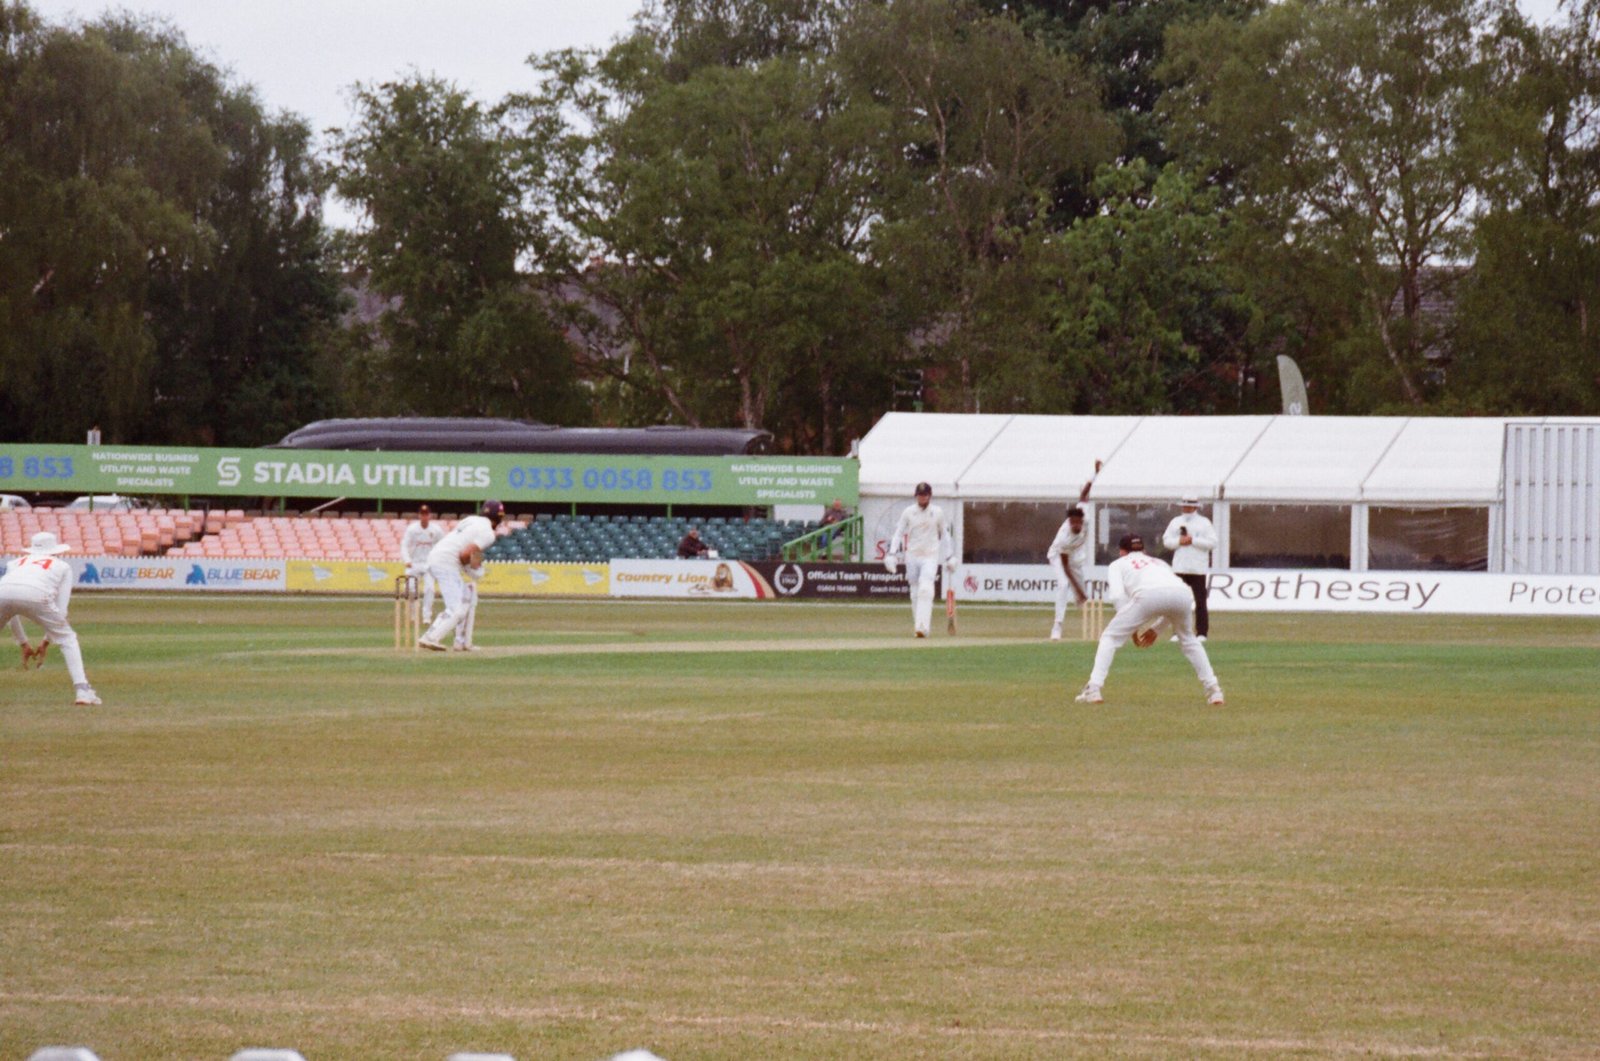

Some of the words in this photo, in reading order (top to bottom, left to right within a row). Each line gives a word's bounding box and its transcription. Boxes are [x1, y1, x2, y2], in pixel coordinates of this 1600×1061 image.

[92, 452, 153, 462] NATIONWIDE
[155, 453, 200, 463] BUSINESS
[23, 456, 75, 479] 853
[99, 464, 134, 474] UTILITY
[136, 465, 157, 475] AND
[159, 466, 192, 475] WASTE
[731, 464, 794, 473] NATIONWIDE
[796, 464, 843, 474] BUSINESS
[253, 461, 356, 485] STADIA
[363, 463, 491, 488] UTILITIES
[508, 466, 574, 490] 0333
[583, 467, 653, 491] 0058
[661, 468, 713, 492] 853
[117, 477, 175, 487] SPECIALISTS
[739, 476, 775, 486] UTILITY
[776, 477, 798, 486] AND
[799, 477, 834, 487] WASTE
[756, 489, 817, 499] SPECIALISTS
[100, 566, 176, 580] BLUEBEAR
[206, 568, 282, 581] BLUEBEAR
[616, 572, 673, 584] Country
[677, 572, 709, 584] Lion
[807, 570, 838, 581] Official
[839, 571, 862, 581] Team
[863, 572, 904, 583] Transport
[984, 579, 1004, 591] DE
[1207, 573, 1441, 610] Rothesay
[1509, 581, 1600, 604] Prote
